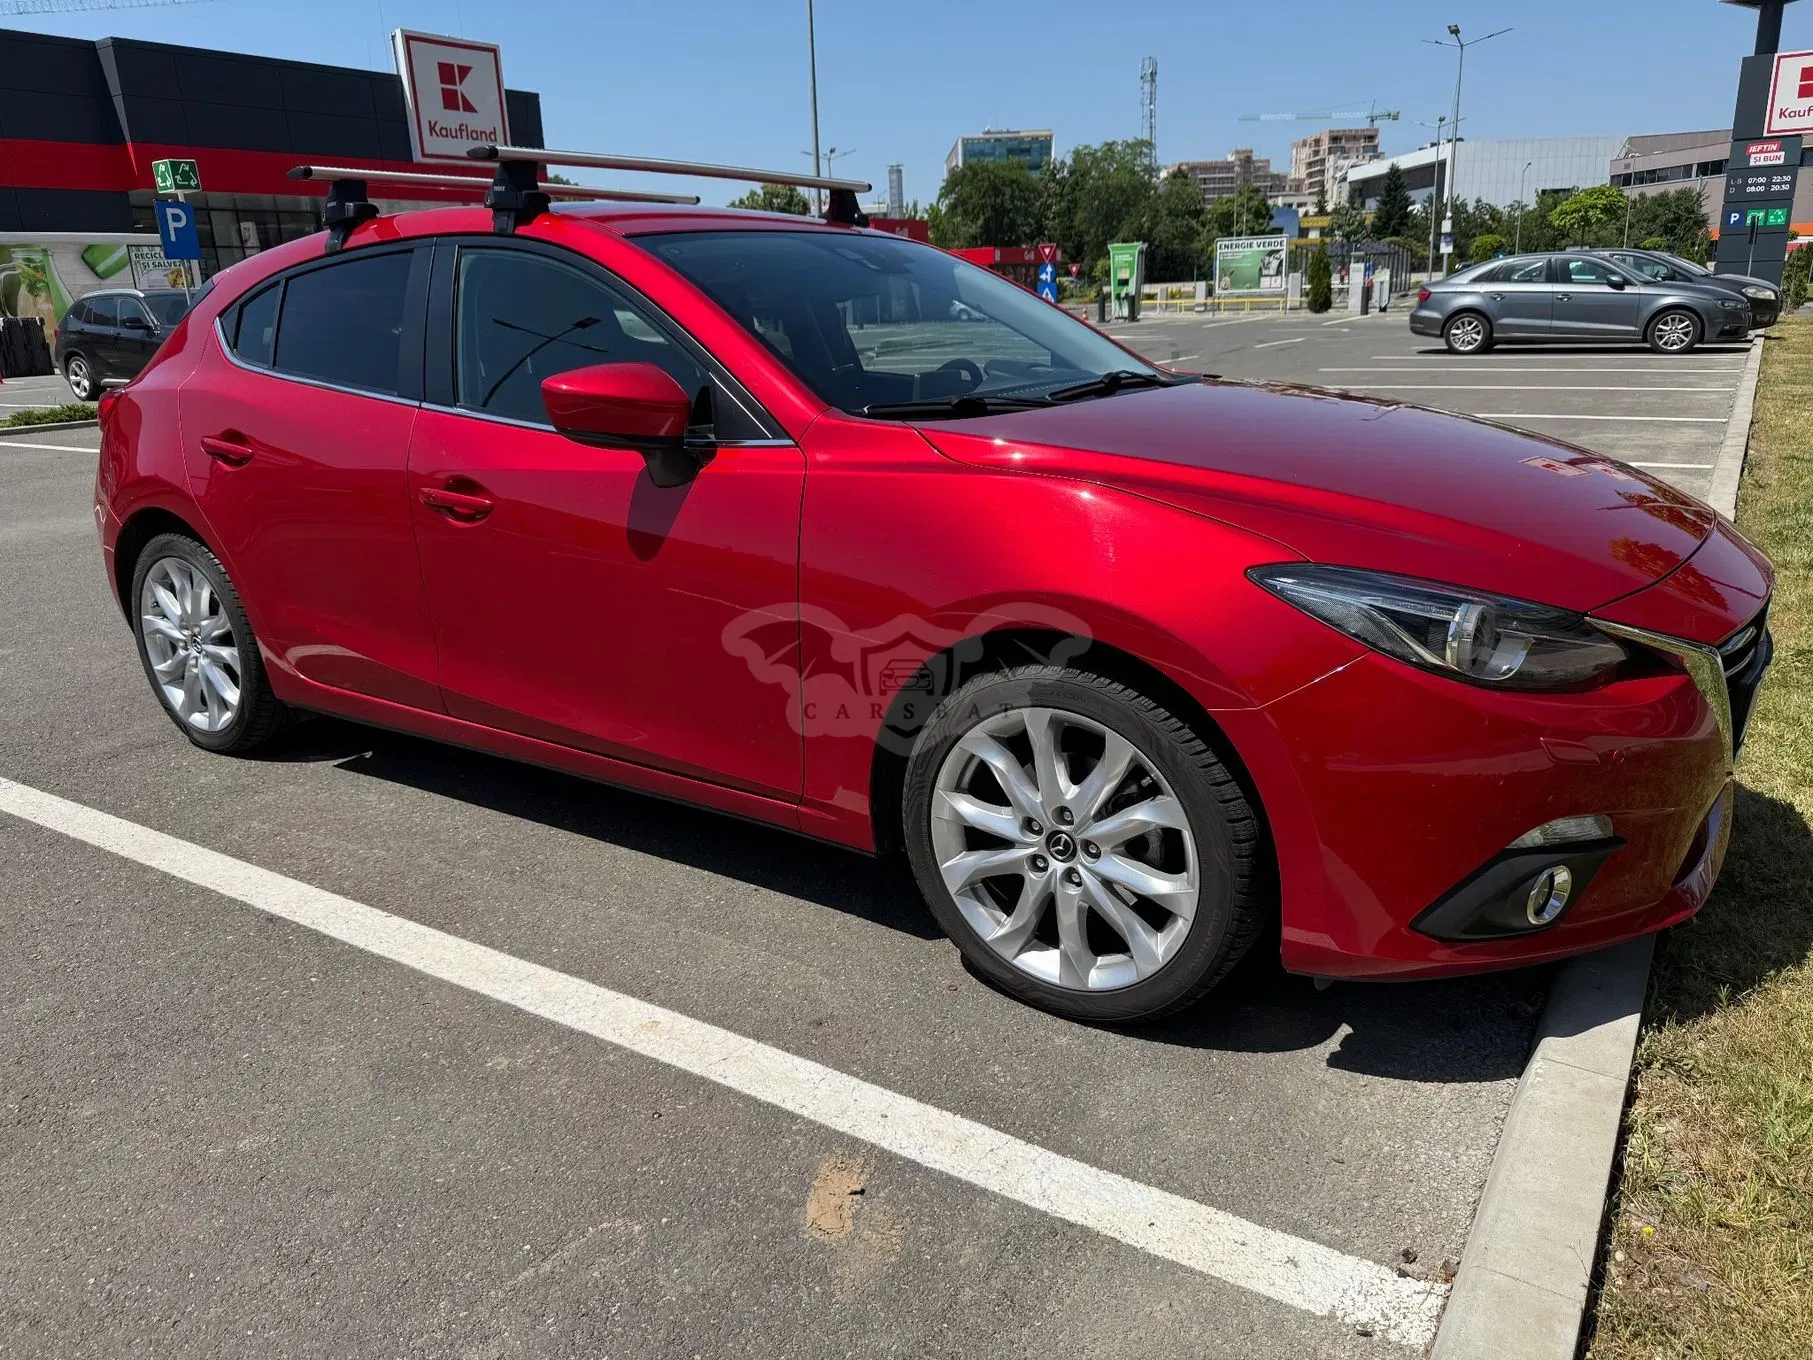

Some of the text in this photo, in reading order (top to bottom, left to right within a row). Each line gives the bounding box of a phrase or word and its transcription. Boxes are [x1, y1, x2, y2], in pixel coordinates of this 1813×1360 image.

[428, 119, 498, 142] Kaufland
[1749, 144, 1778, 153] IEFTIN
[1763, 154, 1782, 162] BUN
[1747, 176, 1767, 184] 07:00
[1771, 175, 1792, 183] 22:30
[1746, 185, 1766, 193] 08:00
[1770, 183, 1790, 191] 20:30
[1730, 213, 1740, 225] P
[165, 207, 187, 242] P
[1219, 240, 1285, 250] ENERGIE VERDE
